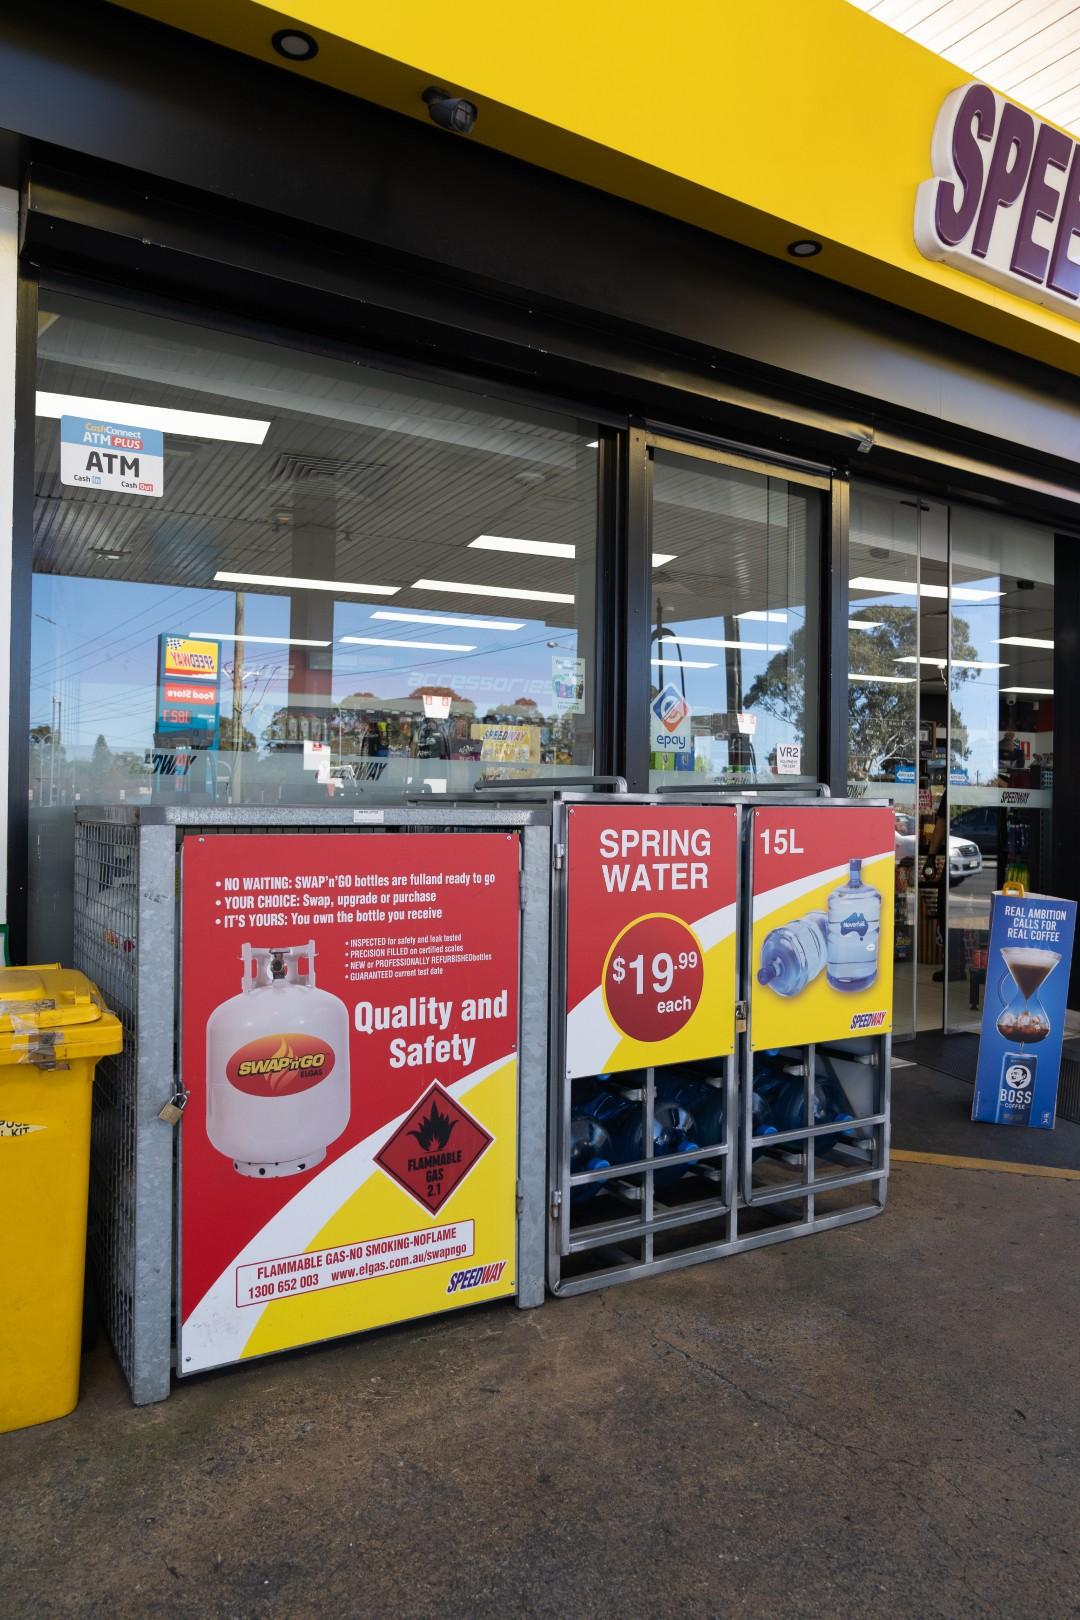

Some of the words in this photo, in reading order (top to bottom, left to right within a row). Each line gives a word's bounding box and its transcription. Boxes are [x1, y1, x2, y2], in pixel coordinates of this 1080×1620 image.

[83, 432, 111, 446] ATM
[114, 437, 141, 449] PLUS
[86, 451, 140, 478] ATM
[121, 481, 138, 489] Cash
[139, 483, 152, 491] Out
[656, 735, 686, 749] epay
[779, 746, 799, 758] VR2
[1001, 791, 1030, 804] SPEEDWAY
[600, 829, 711, 858] SPRING
[760, 829, 804, 855] 15L
[224, 878, 240, 891] NO
[243, 877, 292, 890] WAITING:
[355, 874, 389, 887] bottles
[392, 876, 407, 886] are
[445, 873, 470, 887] ready
[473, 873, 482, 883] to
[484, 874, 496, 885] go
[602, 863, 708, 893] WATER
[224, 896, 255, 910] YOUR
[258, 895, 300, 909] CHOICE:
[303, 894, 334, 908] Swap,
[337, 892, 377, 907] upgrade
[380, 894, 391, 904] or
[393, 891, 437, 905] purchase
[224, 915, 246, 928] IT'S
[249, 913, 288, 927] YOURS:
[291, 913, 310, 925] You
[313, 914, 334, 924] own
[336, 911, 353, 923] the
[356, 909, 385, 922] bottle
[388, 911, 405, 923] you
[407, 907, 443, 920] receive
[1004, 906, 1026, 918] REAL
[1028, 908, 1067, 920] AMBITION
[1013, 917, 1039, 930] CALLS
[1041, 920, 1057, 931] FOR
[350, 937, 386, 948] INSPECTED
[387, 936, 396, 946] for
[397, 935, 416, 946] safety
[417, 936, 428, 944] and
[430, 934, 443, 943] leak
[443, 933, 462, 942] tested
[1007, 927, 1029, 939] REAL
[1030, 930, 1061, 942] COFFEE
[350, 949, 385, 959] PRECISION
[387, 947, 409, 956] FILLED
[418, 946, 443, 955] certified
[444, 944, 464, 953] scales
[350, 961, 365, 970] NEW
[375, 956, 430, 968] PROFESSIONALLY
[350, 969, 393, 981] GUARANTEED
[394, 968, 417, 978] current
[417, 966, 429, 976] test
[430, 965, 443, 975] date
[354, 997, 453, 1034] Quality
[461, 990, 508, 1021] and
[657, 996, 692, 1013] each
[850, 1011, 887, 1030] SPEEDWAY
[389, 1033, 476, 1069] Safety
[300, 1068, 324, 1078] ELGAS
[1000, 1088, 1032, 1104] BOSS
[1004, 1102, 1025, 1110] COFFEE
[408, 1150, 462, 1172] FLAMMABLE
[426, 1168, 444, 1183] GAS
[427, 1183, 441, 1197] 2.1
[248, 1282, 275, 1299] 1300
[277, 1278, 297, 1293] 652
[299, 1273, 319, 1288] 003
[331, 1243, 467, 1282] www.elgas.com.au/swapngo
[257, 1257, 323, 1280] FLAMMABLE
[325, 1246, 363, 1266] GAS-NO
[446, 1261, 508, 1293] SPEEDWAY
